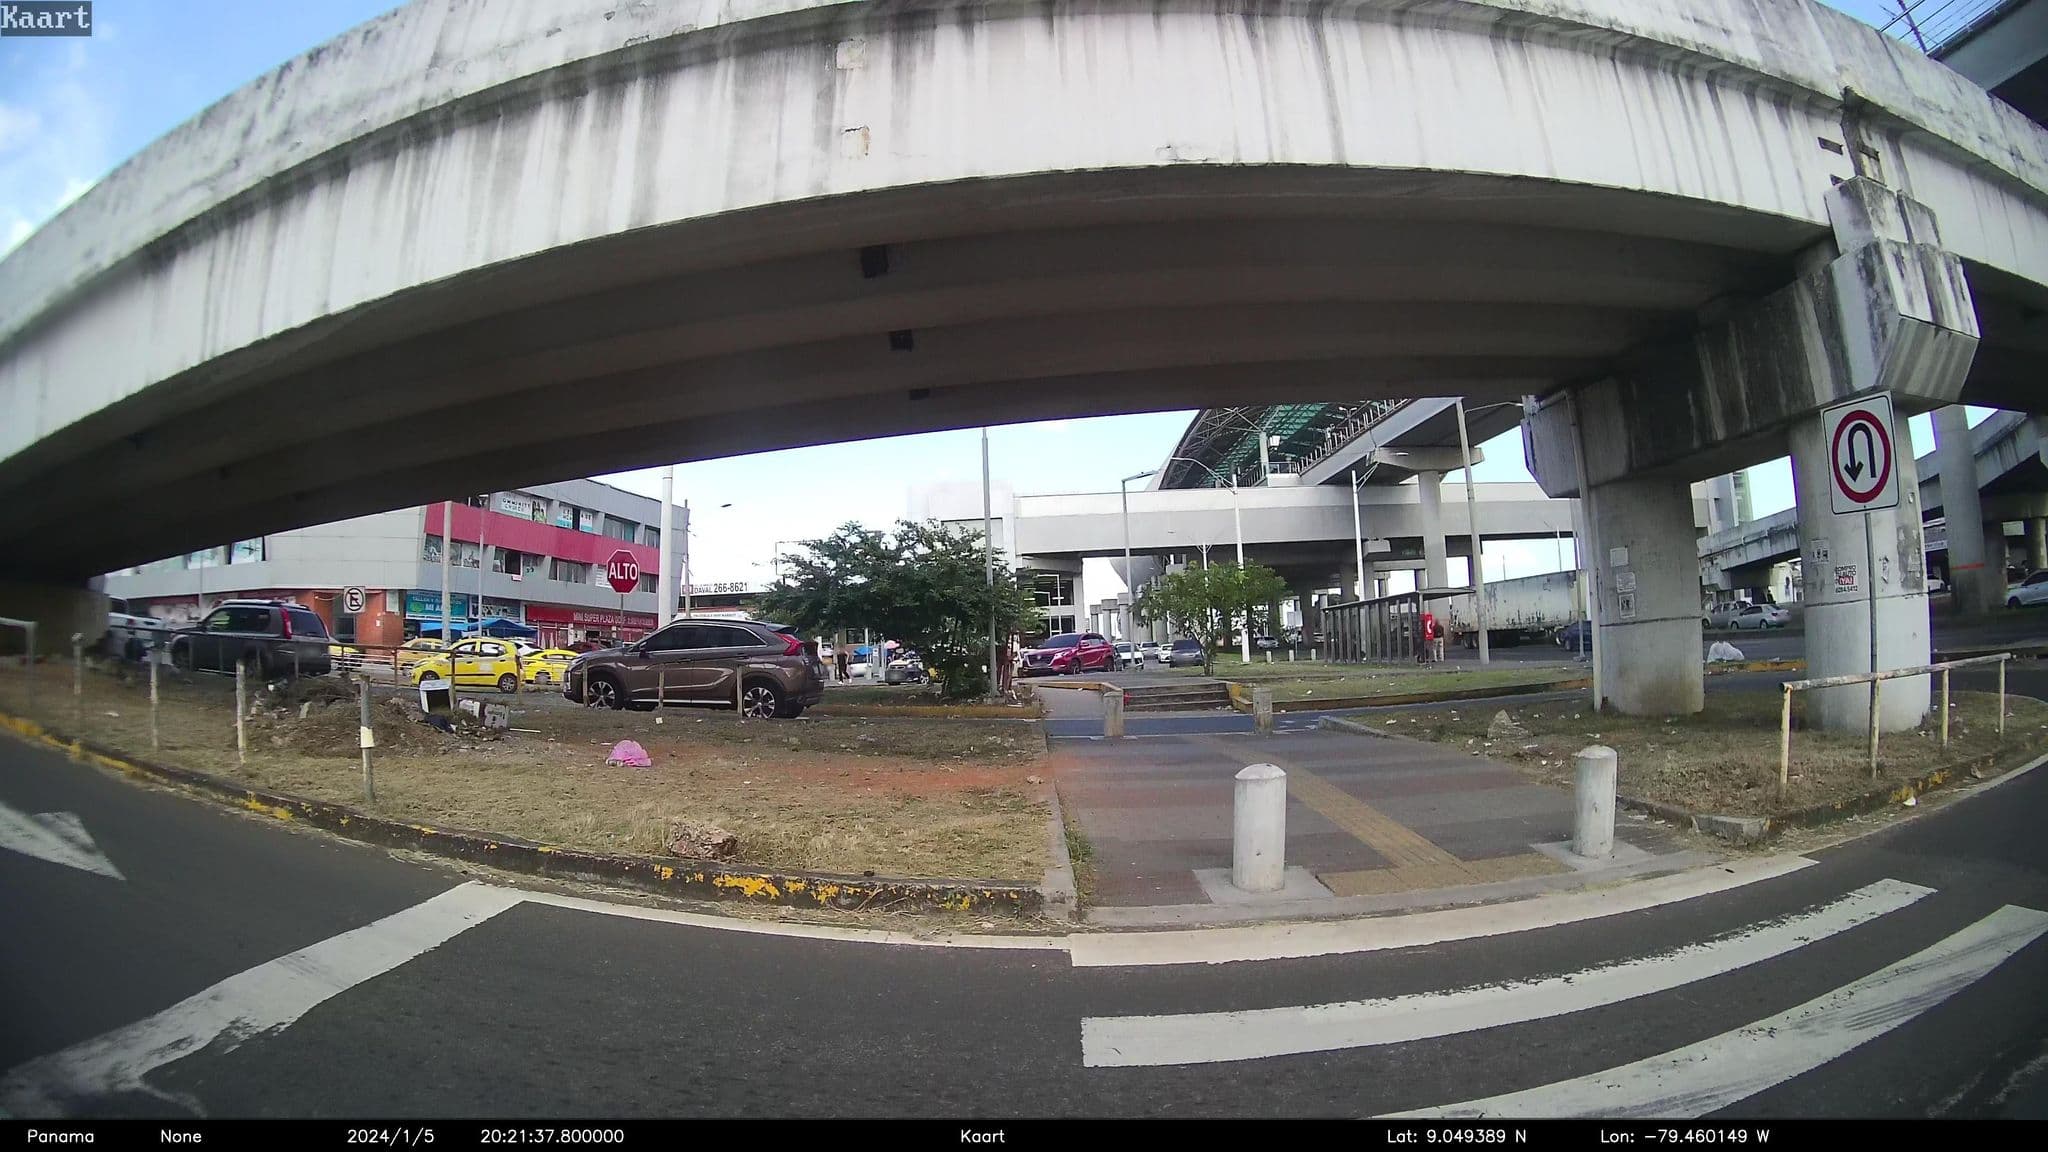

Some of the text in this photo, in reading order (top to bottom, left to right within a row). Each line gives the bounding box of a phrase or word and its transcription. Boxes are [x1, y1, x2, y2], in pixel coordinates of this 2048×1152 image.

[608, 562, 638, 580] ALTO
[713, 582, 748, 593] 266-8621
[584, 613, 600, 623] SUPER
[600, 614, 614, 625] PLAZA
